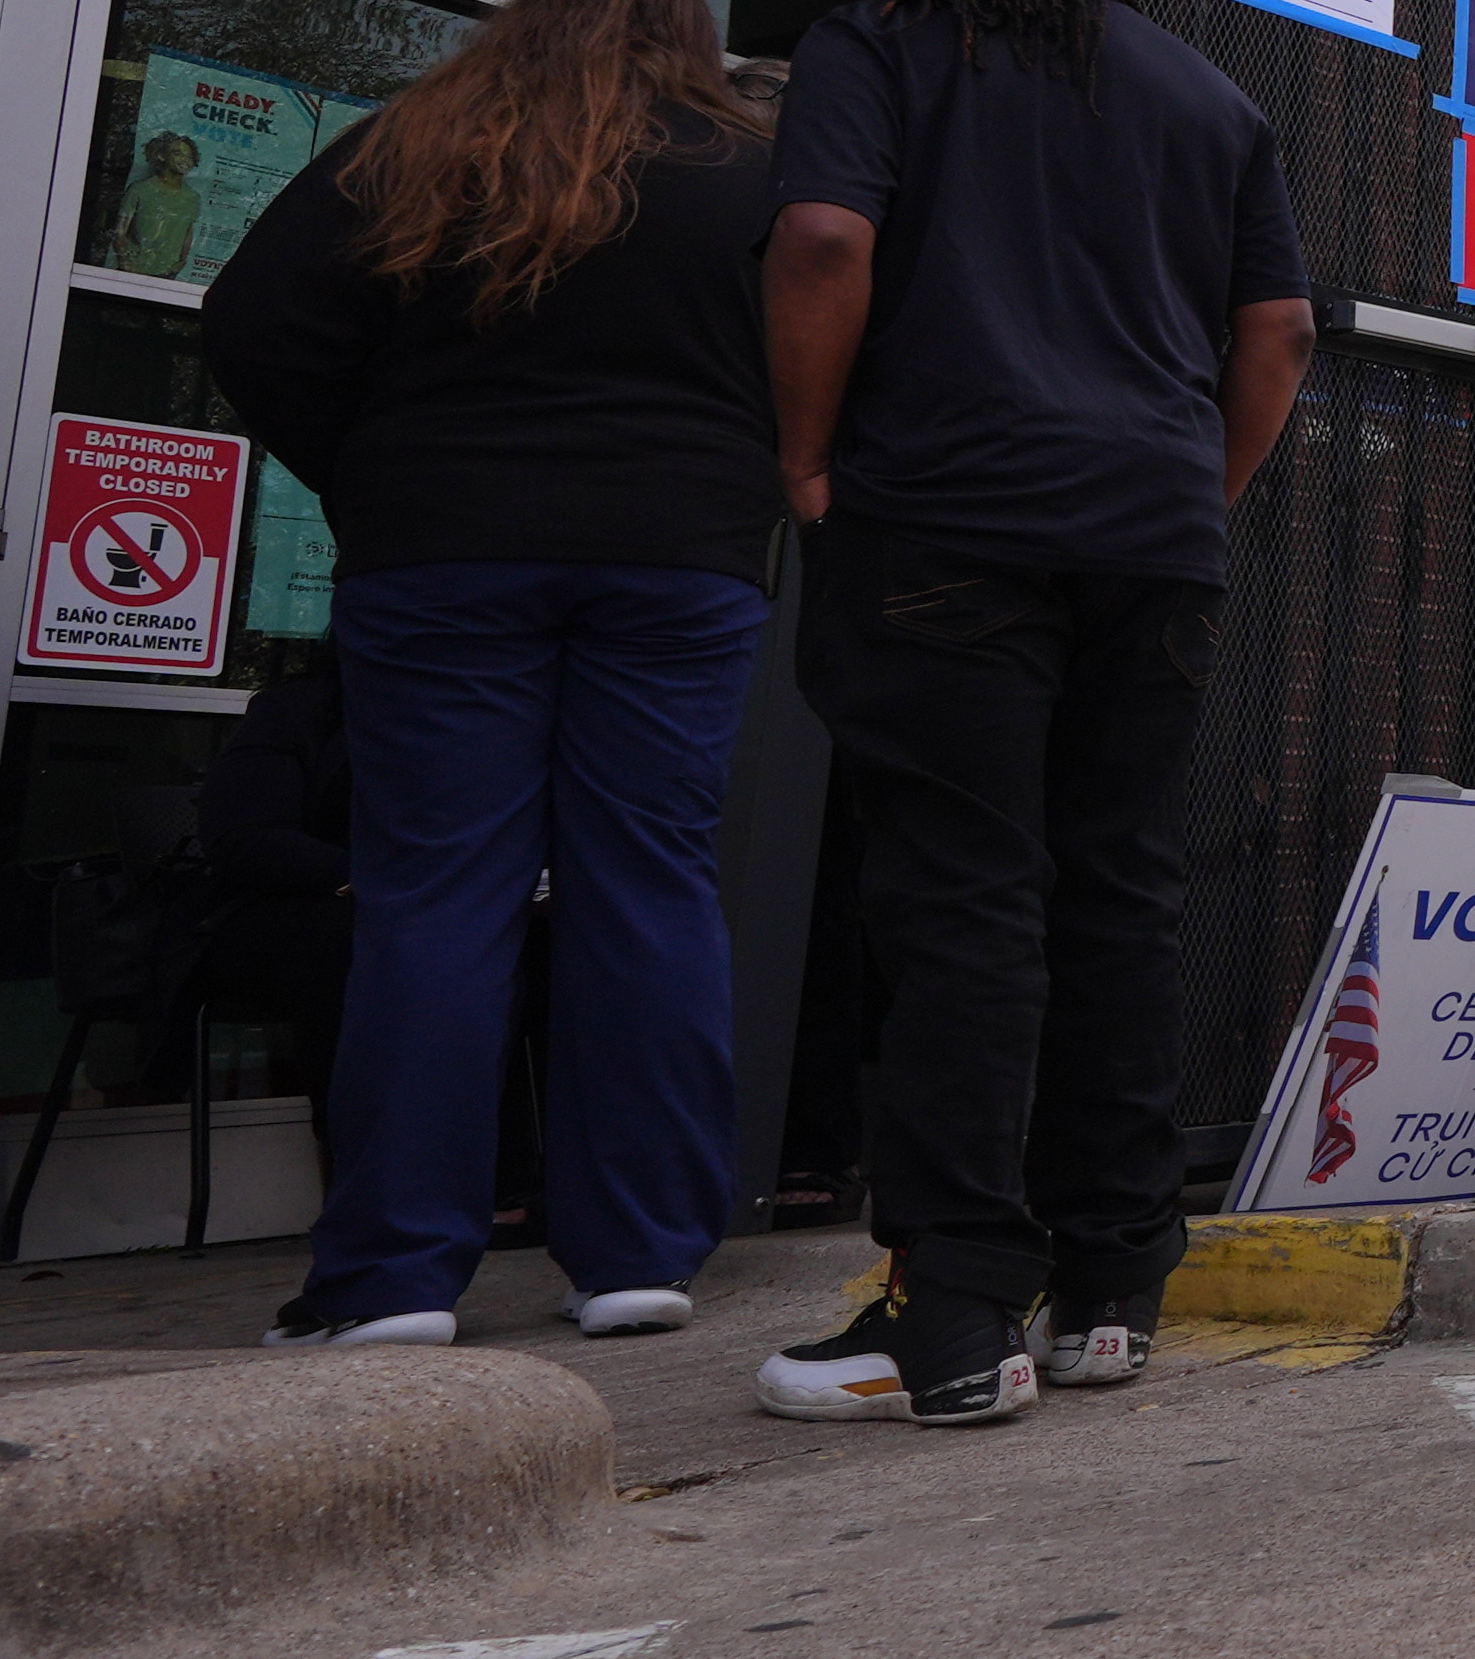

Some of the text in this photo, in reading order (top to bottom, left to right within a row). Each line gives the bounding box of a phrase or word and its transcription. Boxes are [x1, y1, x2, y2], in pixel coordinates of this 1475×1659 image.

[195, 82, 275, 115] READY.
[192, 103, 278, 136] CHECK.
[84, 430, 215, 461] BATHROOM
[65, 448, 229, 482] TEMPORARILY
[99, 474, 191, 498] CLOSED
[56, 606, 197, 631] BAÑO CERRADO
[44, 628, 204, 653] TEMPORALMENTE
[1095, 1338, 1120, 1355] 23
[1011, 1366, 1030, 1387] 23
